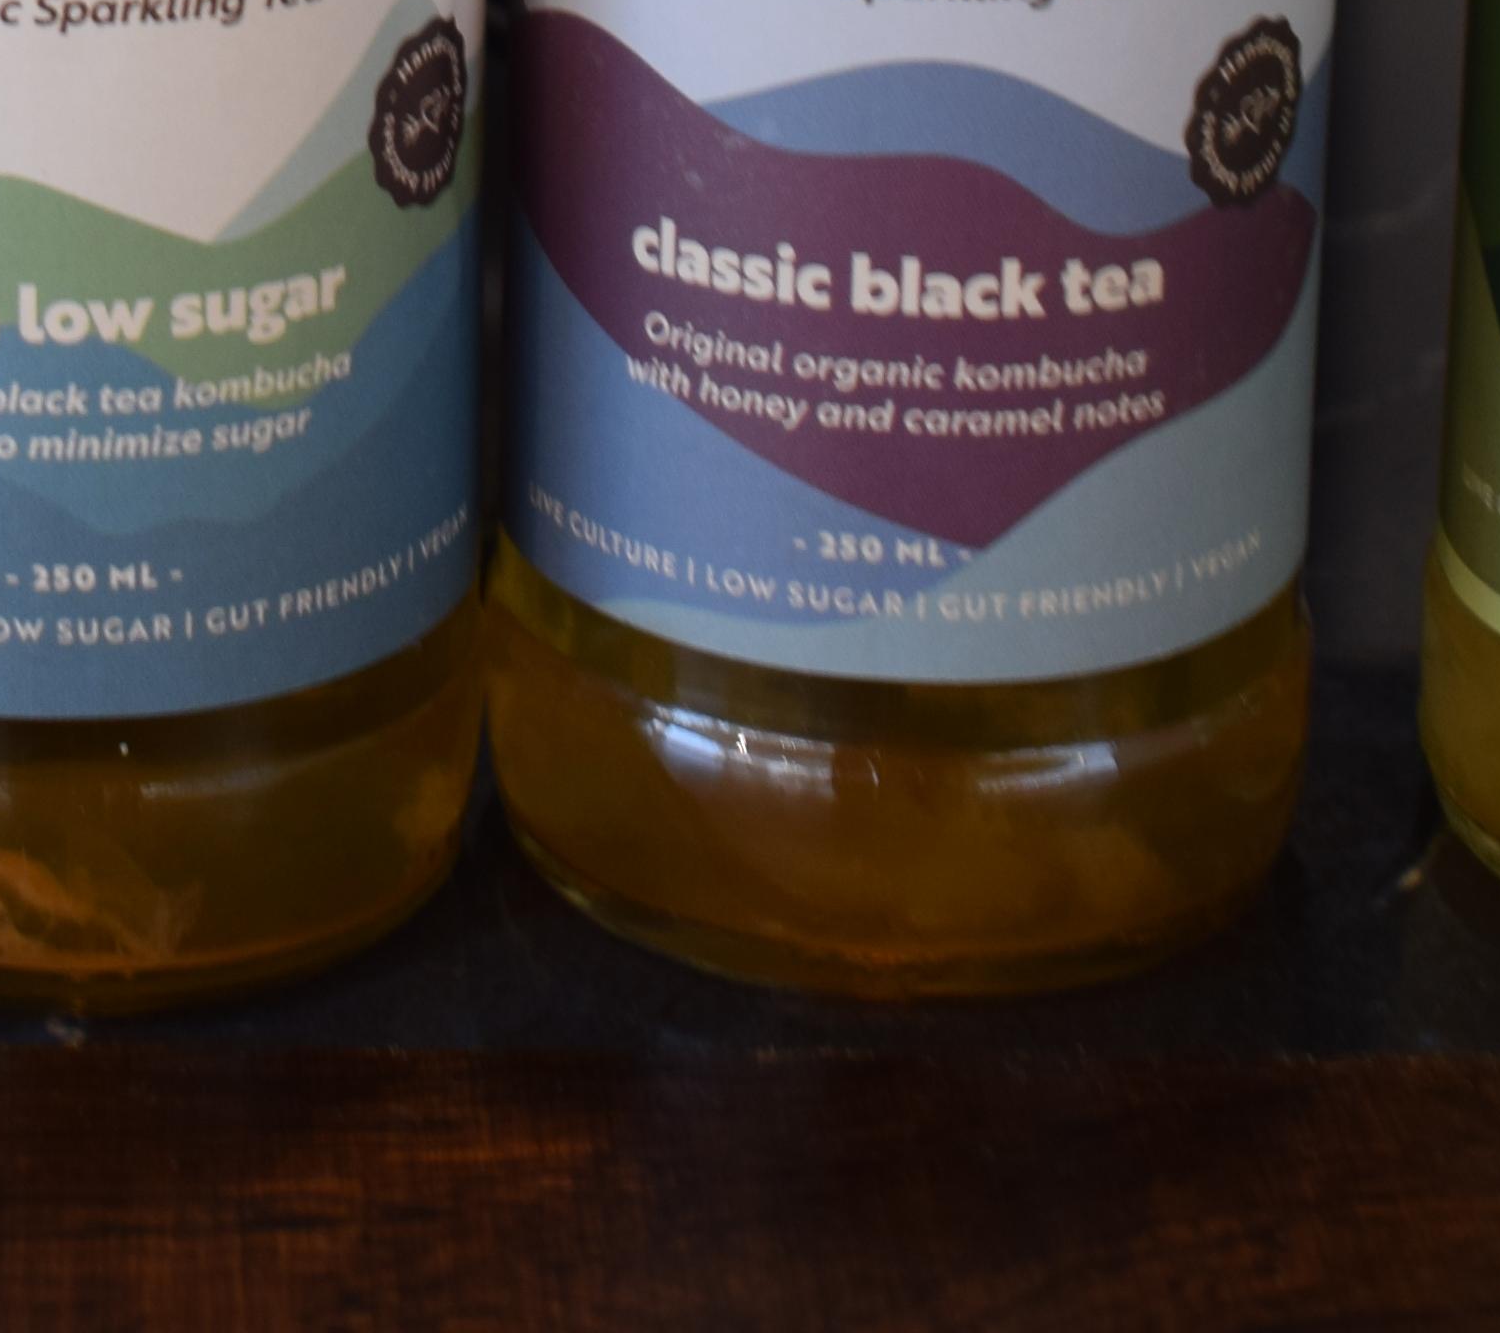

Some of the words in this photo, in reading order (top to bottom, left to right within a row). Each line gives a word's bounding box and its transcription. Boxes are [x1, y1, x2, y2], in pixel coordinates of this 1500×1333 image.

[18, 284, 150, 344] low
[171, 265, 346, 346] sugar
[632, 216, 833, 309] classic
[850, 252, 1048, 319] black
[1060, 256, 1165, 309] tea
[98, 379, 162, 413] tea
[174, 351, 352, 408] kombucha
[644, 311, 783, 375] Original
[794, 353, 941, 392] organic
[953, 348, 1147, 389] kombucha
[29, 426, 202, 461] minimize
[212, 408, 311, 458] sugar
[625, 353, 690, 399] with
[700, 372, 807, 431] honey
[818, 397, 894, 434] and
[904, 398, 1064, 437] caramel
[1074, 391, 1165, 429] notes
[32, 564, 93, 592] 250
[107, 562, 159, 590] ML
[568, 509, 676, 581] CULTURE
[705, 566, 776, 602] LOW
[788, 579, 902, 618] SUGAR
[938, 592, 1005, 621] GUT
[1019, 568, 1166, 618] FRIENDLY
[820, 534, 883, 564] 250
[896, 538, 944, 565] ML
[56, 614, 172, 644] SUGAR
[207, 601, 268, 635] GUT
[279, 555, 404, 621] FRIENDLY
